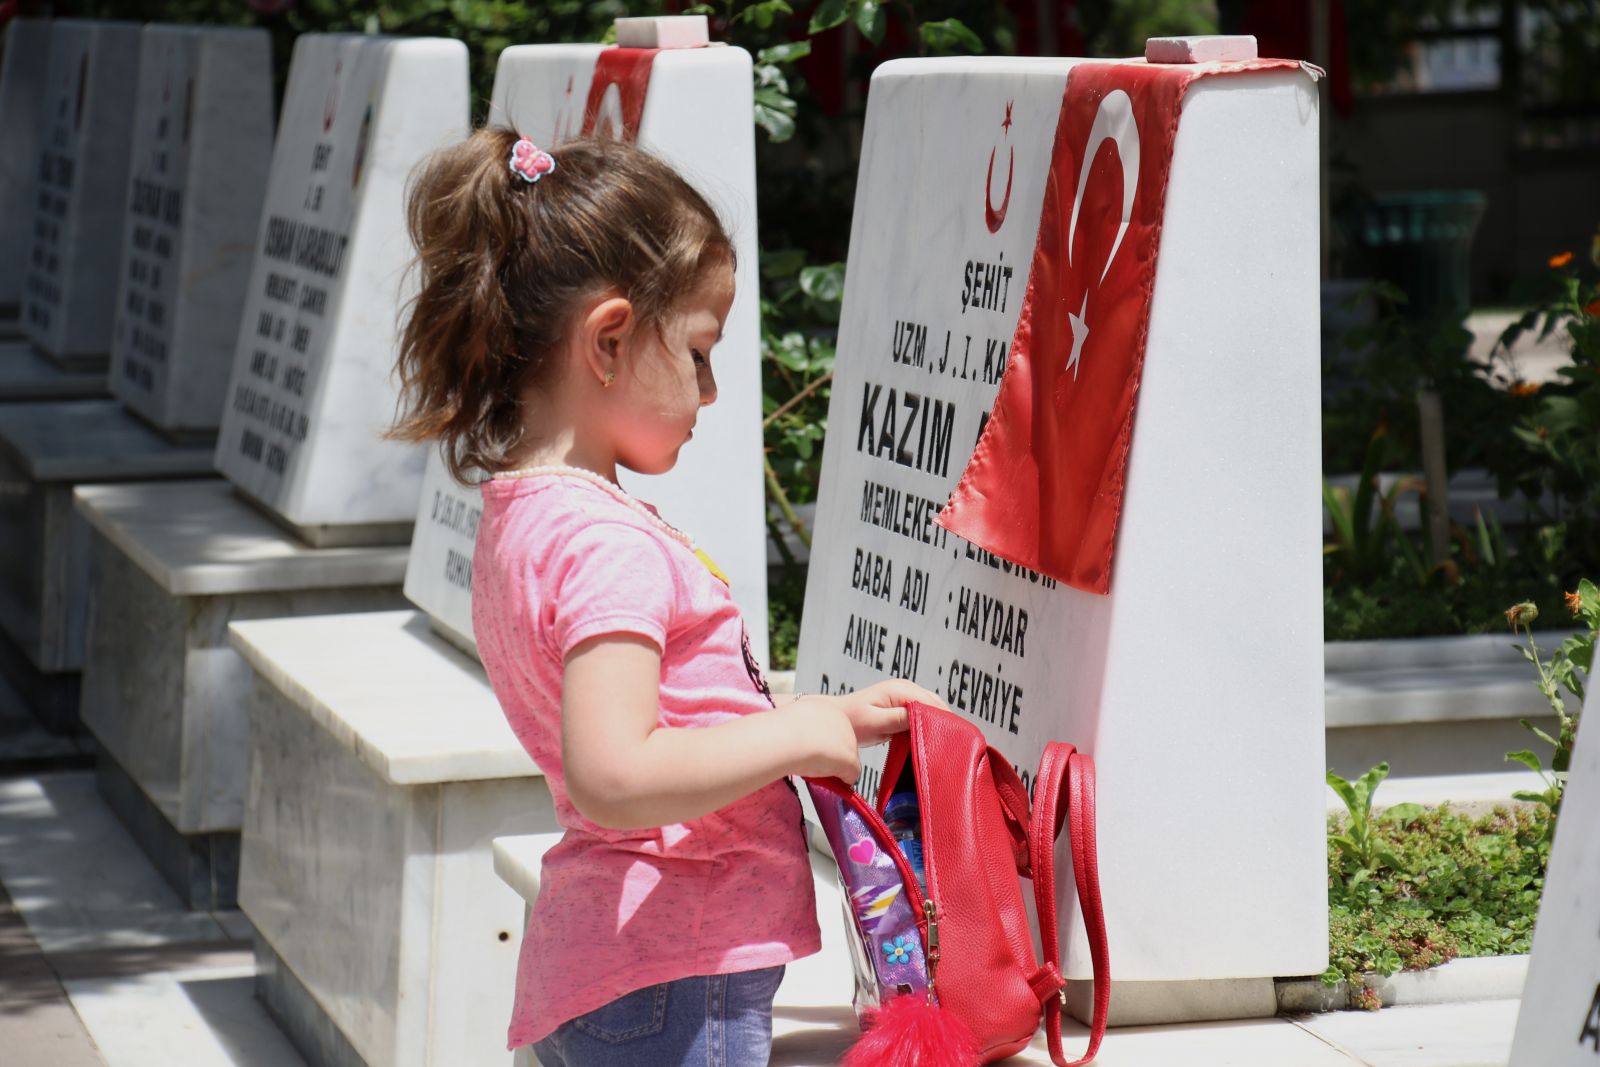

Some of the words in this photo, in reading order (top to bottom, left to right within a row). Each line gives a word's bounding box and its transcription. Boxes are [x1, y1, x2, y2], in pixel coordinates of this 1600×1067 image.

[961, 252, 1013, 314] ŞEHİT
[857, 382, 956, 478] KAZIM
[852, 547, 892, 603] BABA
[900, 565, 930, 616] ADI
[843, 613, 888, 672] ANNE
[890, 634, 920, 683] ADI
